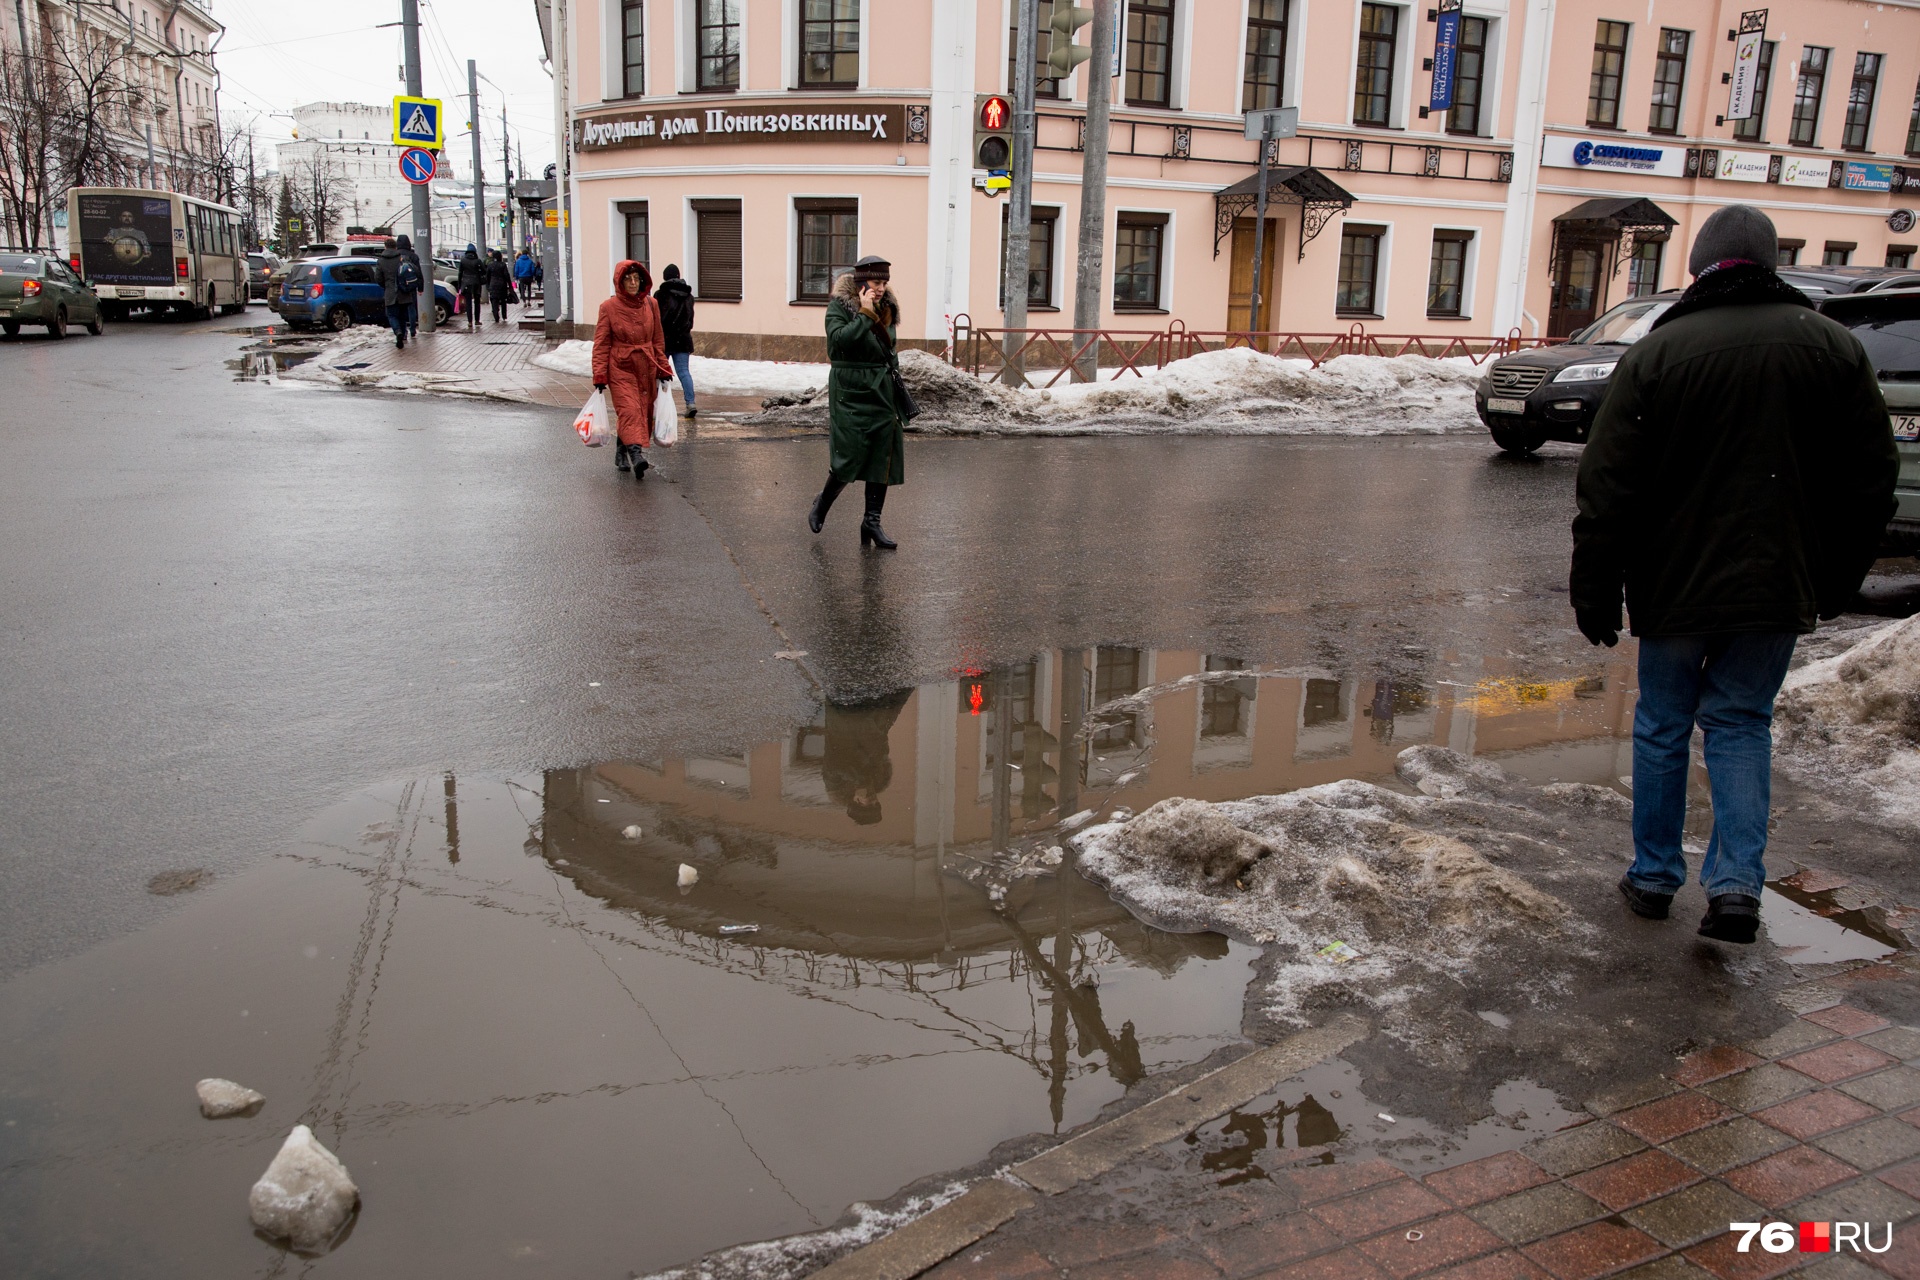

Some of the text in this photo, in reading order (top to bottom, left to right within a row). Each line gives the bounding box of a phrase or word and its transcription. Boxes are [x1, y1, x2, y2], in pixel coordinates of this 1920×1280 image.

[1733, 66, 1745, 114] АКАДЕМИЯ
[583, 115, 655, 146] Доходный
[660, 117, 699, 141] дом
[705, 110, 887, 139] Понизовкиных
[1593, 145, 1663, 162] CUSTODIAN
[1735, 164, 1766, 172] АКАДЕМИЯ
[1798, 169, 1828, 177] АКАДЕМИЯ
[174, 230, 184, 241] 82
[1899, 417, 1915, 430] 76
